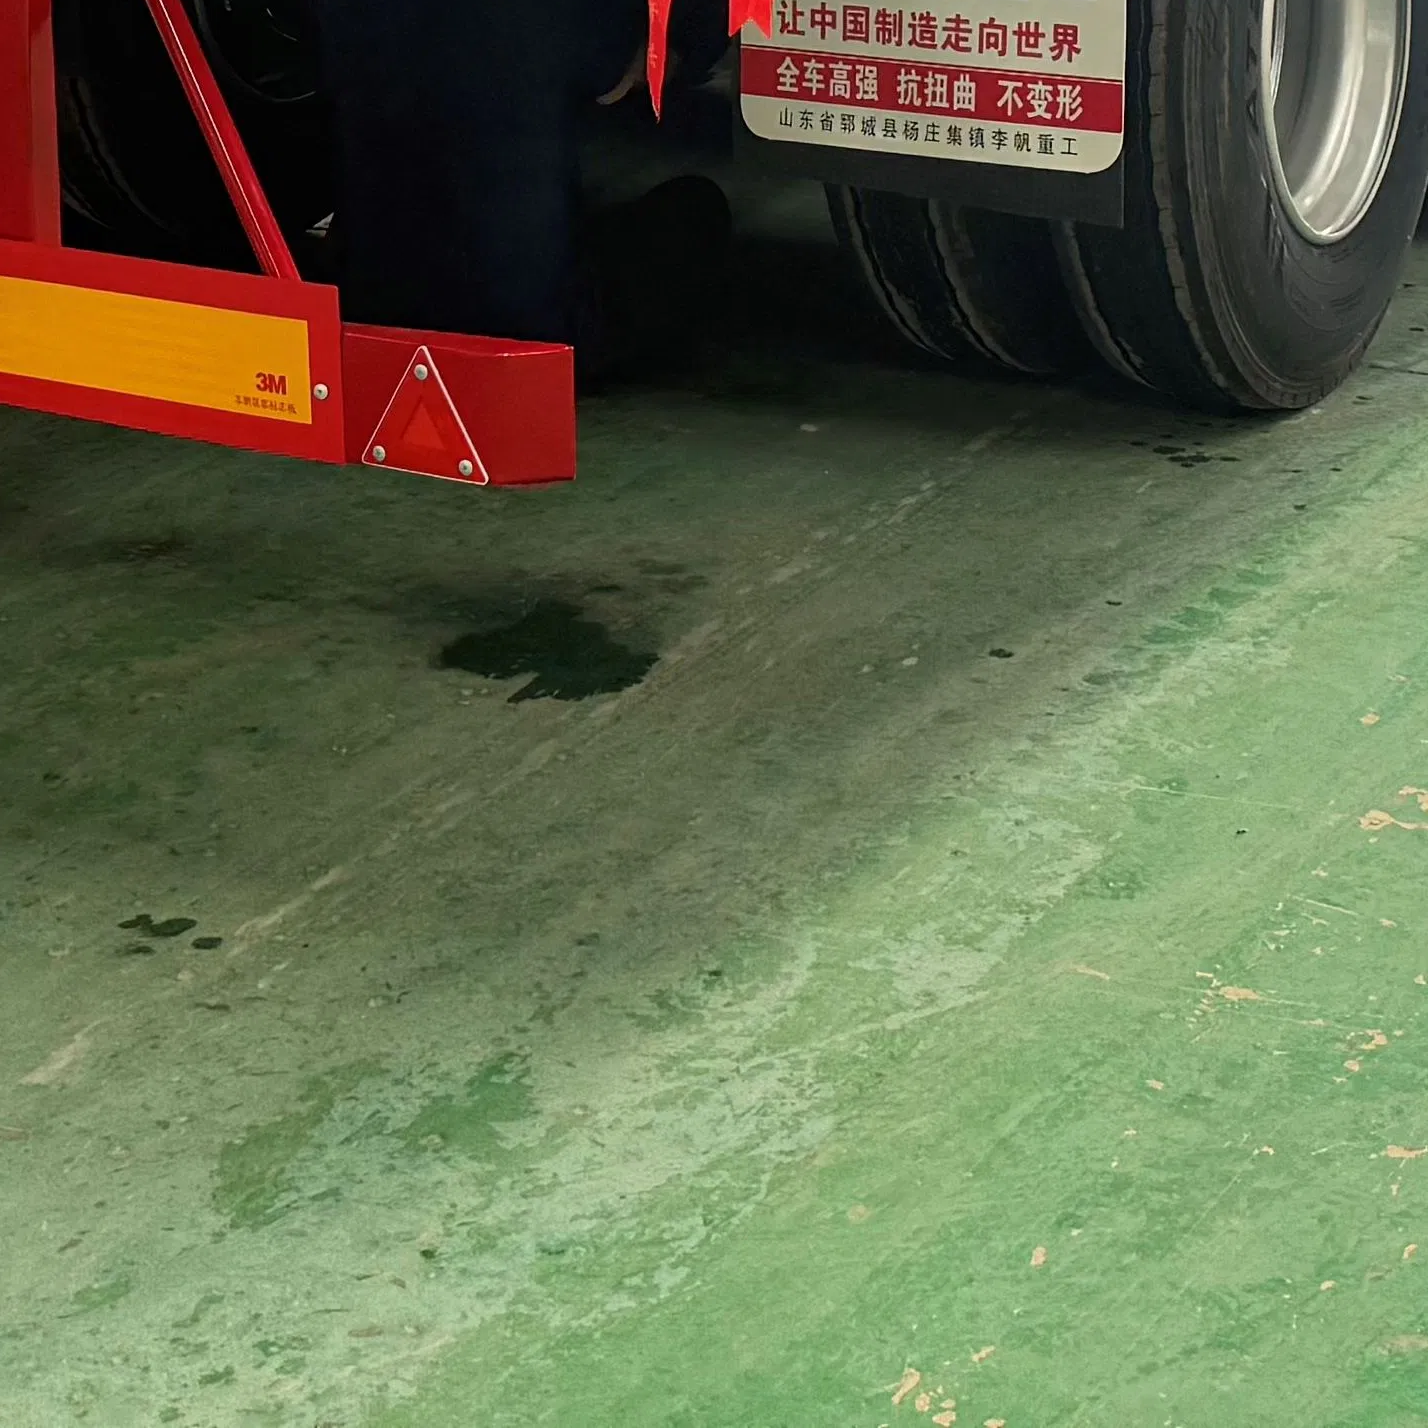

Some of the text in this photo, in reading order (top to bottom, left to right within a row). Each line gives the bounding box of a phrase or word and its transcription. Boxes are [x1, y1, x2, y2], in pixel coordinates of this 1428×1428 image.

[776, 0, 1083, 63] 让中国制造走向世界
[776, 55, 1085, 122] 全车高强 抗扭曲 不变形
[778, 105, 1080, 157] 山东省郓城县杨庄集镇李帆重工
[255, 372, 286, 395] 3M
